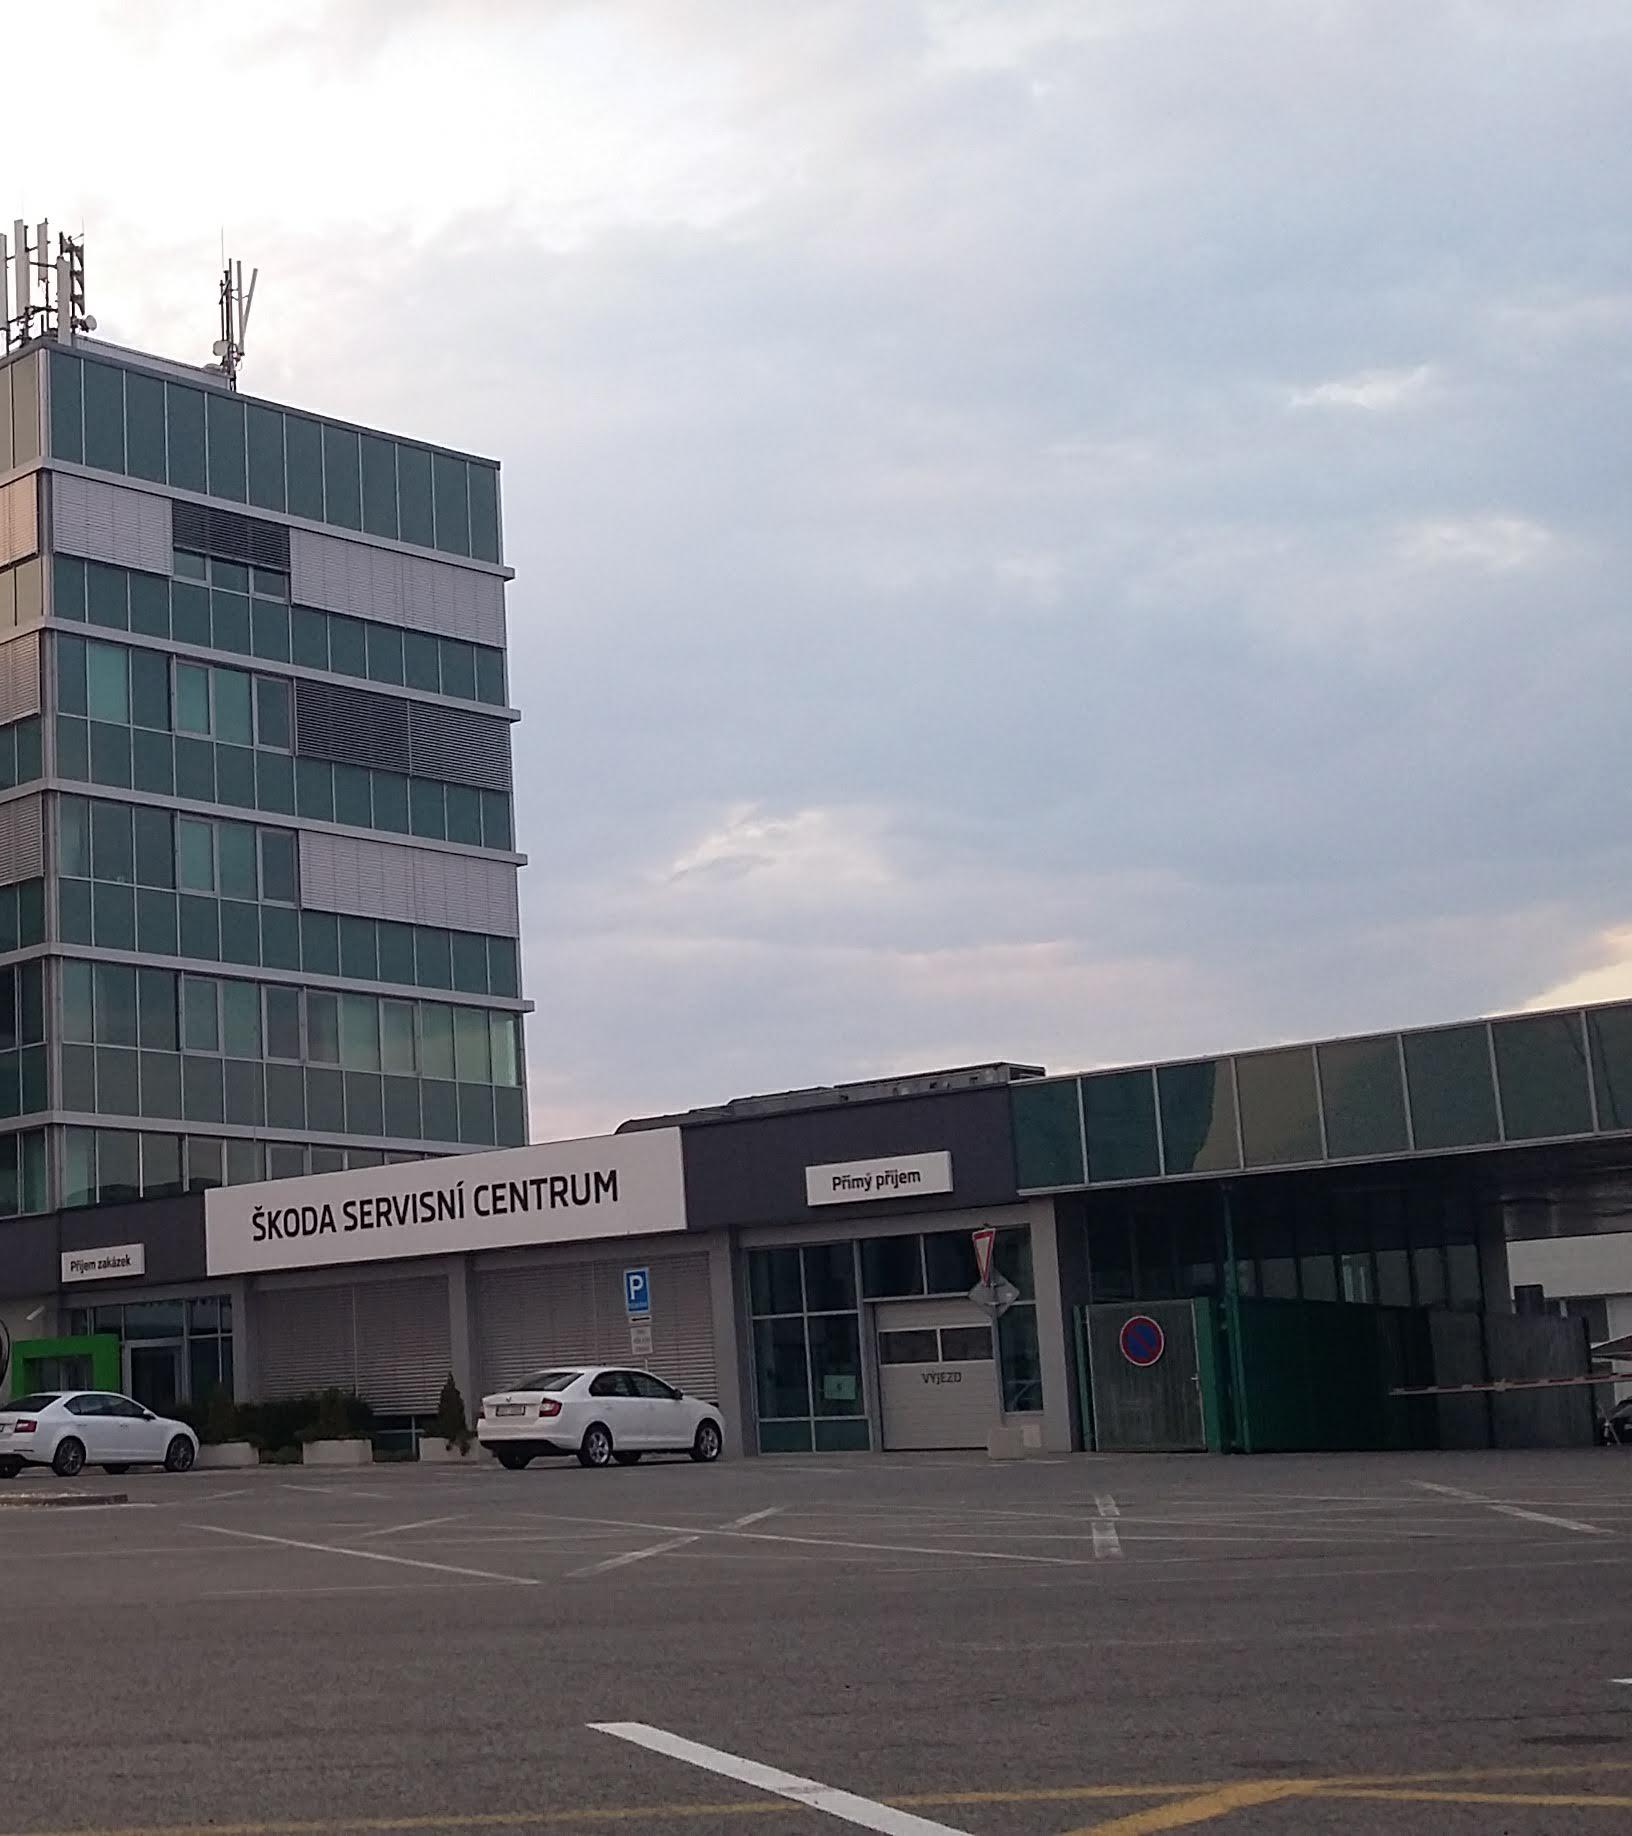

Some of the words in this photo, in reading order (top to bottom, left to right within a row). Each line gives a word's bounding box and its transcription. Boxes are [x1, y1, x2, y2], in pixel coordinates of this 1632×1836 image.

[252, 1205, 337, 1242] ŠKODA
[342, 1181, 465, 1232] SERVISNÍ
[473, 1169, 619, 1217] CENTRUM
[629, 1275, 644, 1300] P
